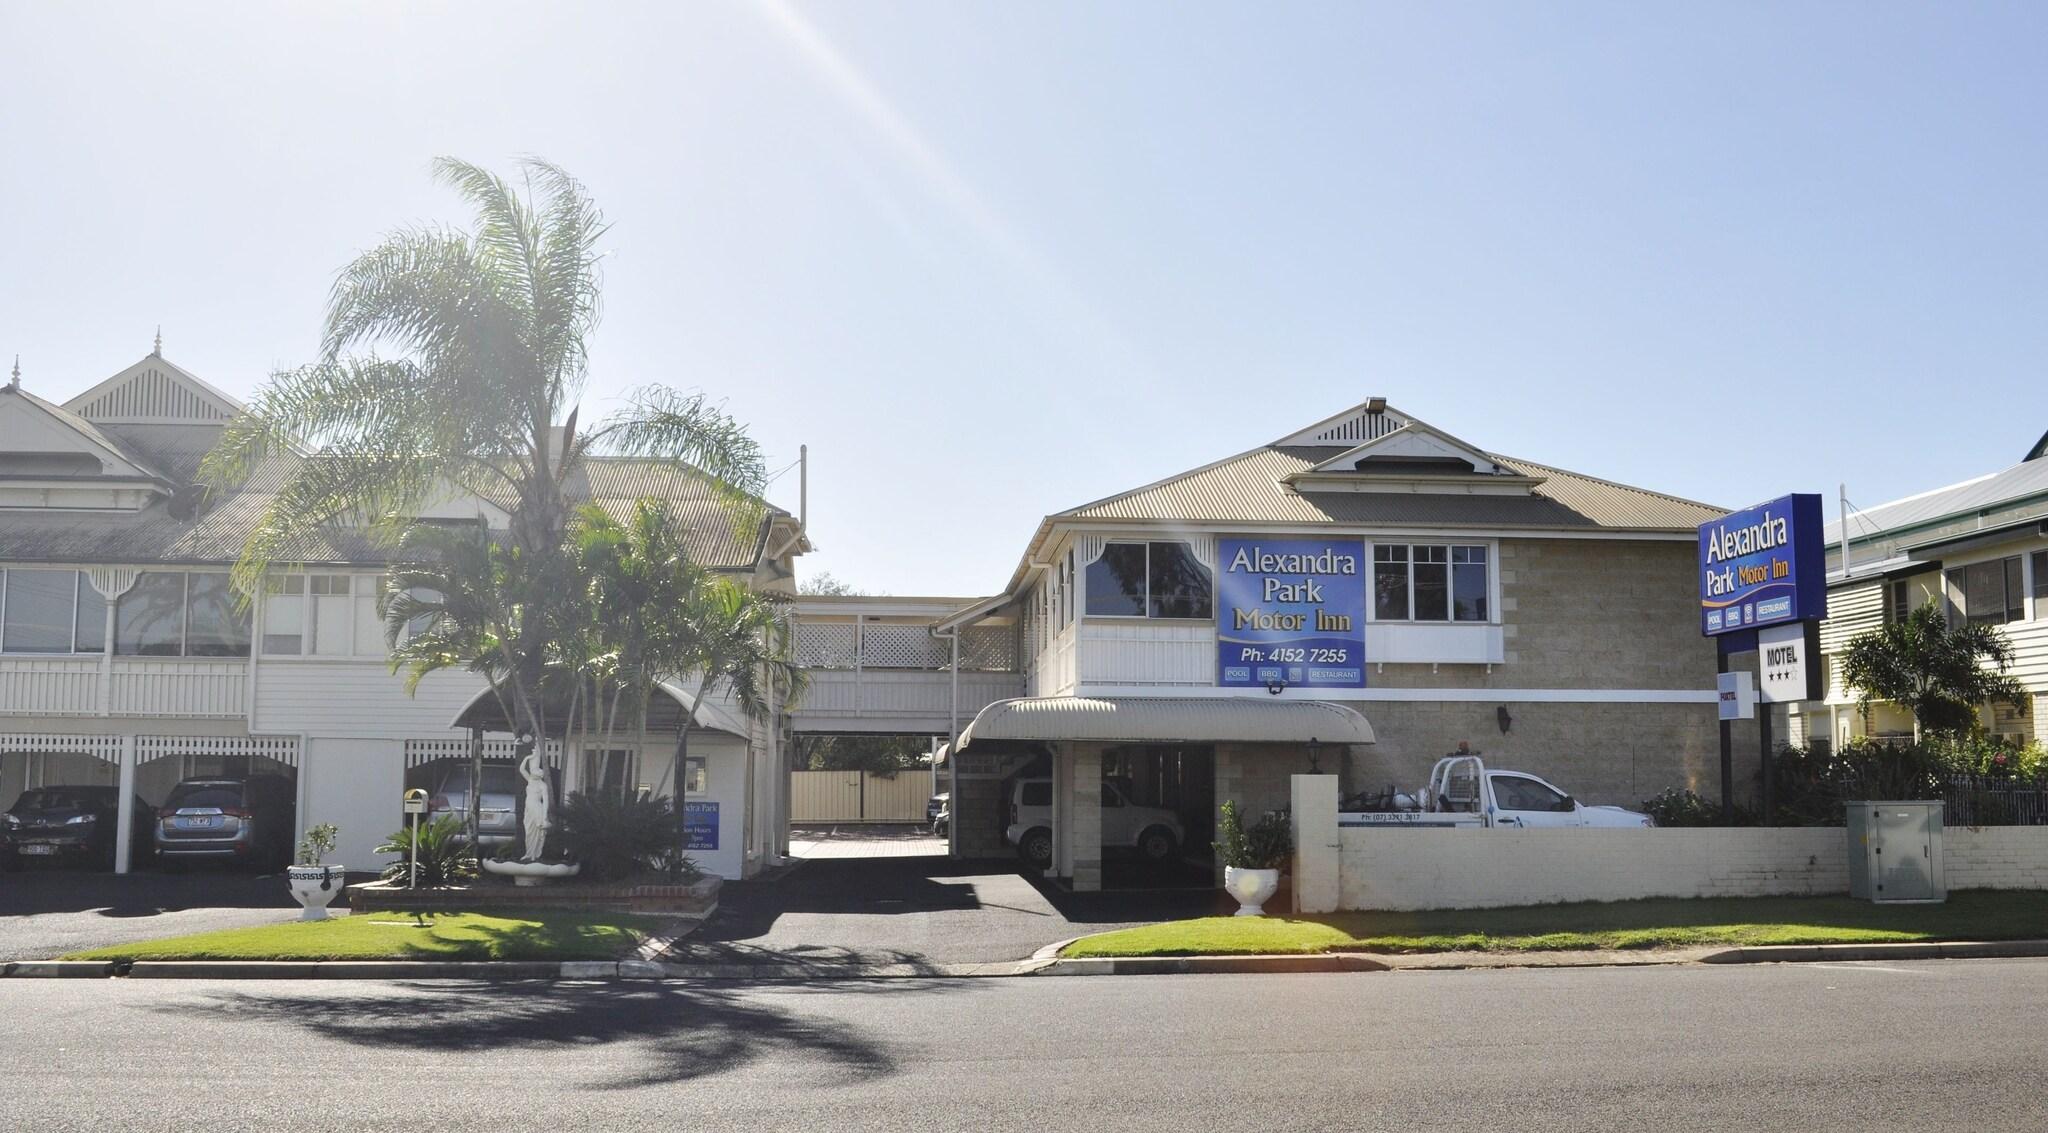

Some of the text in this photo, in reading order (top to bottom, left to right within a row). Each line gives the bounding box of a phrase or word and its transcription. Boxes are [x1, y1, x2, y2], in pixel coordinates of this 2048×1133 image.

[1706, 511, 1787, 564] Alexandra
[1229, 547, 1356, 574] Alexandra
[1706, 557, 1789, 597] Park Motor Inn
[1263, 577, 1324, 602] Park
[1759, 601, 1789, 614] RESTAURANT
[1234, 608, 1351, 632] Motor Inn
[1240, 647, 1347, 663] Ph: 4152 7255
[1767, 645, 1797, 667] MOTEL
[1311, 671, 1357, 679] RESTAURANT
